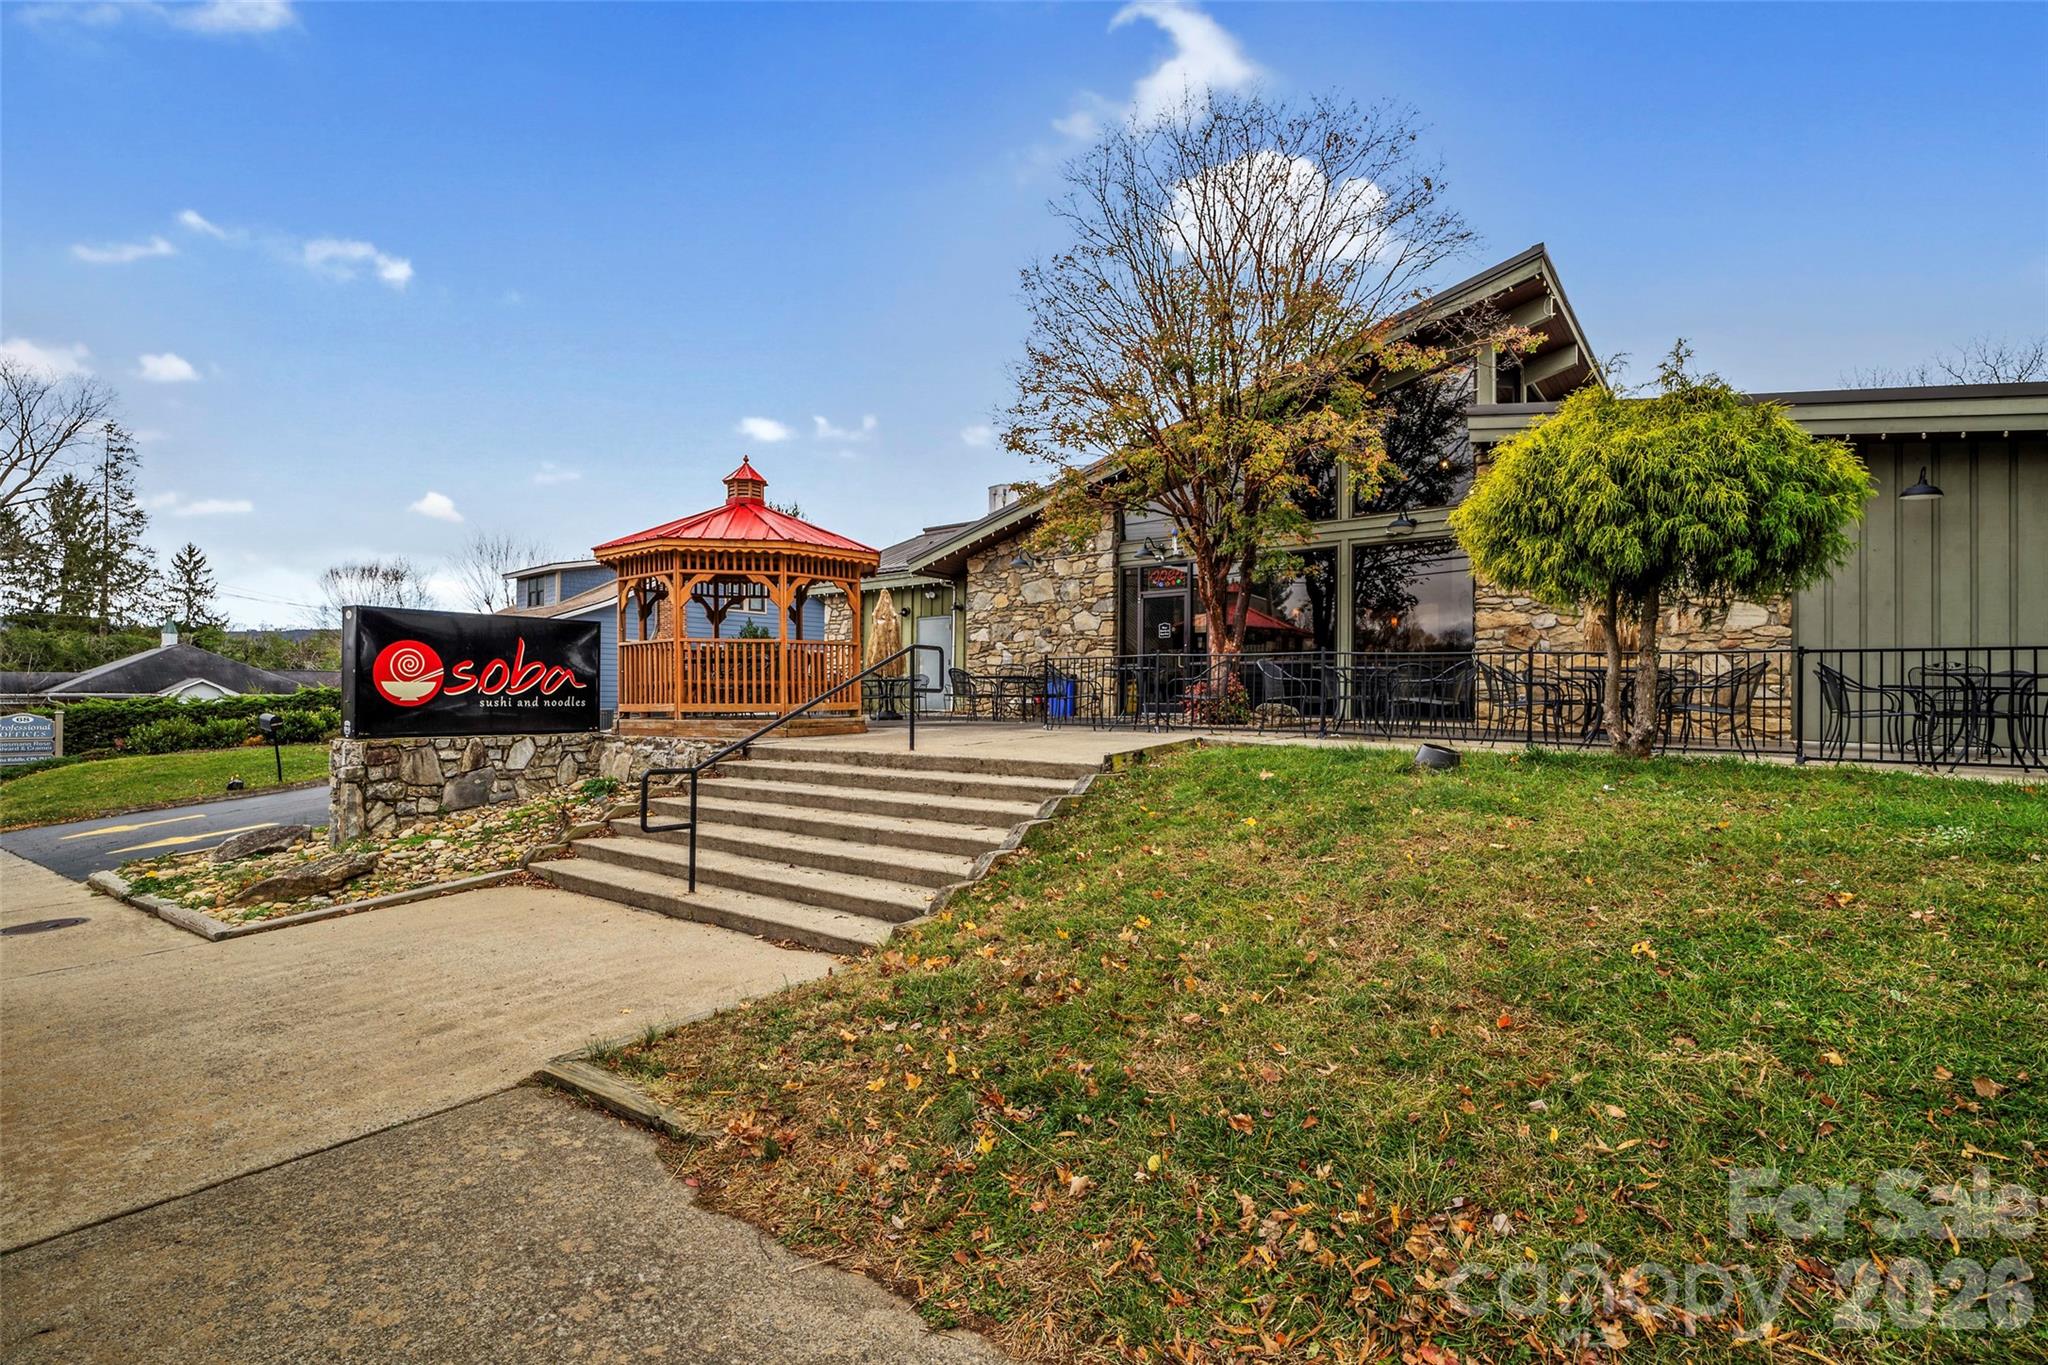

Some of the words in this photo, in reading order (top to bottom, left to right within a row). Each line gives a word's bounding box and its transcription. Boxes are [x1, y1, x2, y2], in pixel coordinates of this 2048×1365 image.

[443, 637, 587, 695] soba
[479, 696, 512, 708] sushi
[517, 696, 539, 708] and
[543, 696, 586, 708] noodles
[0, 724, 51, 732] rofessional
